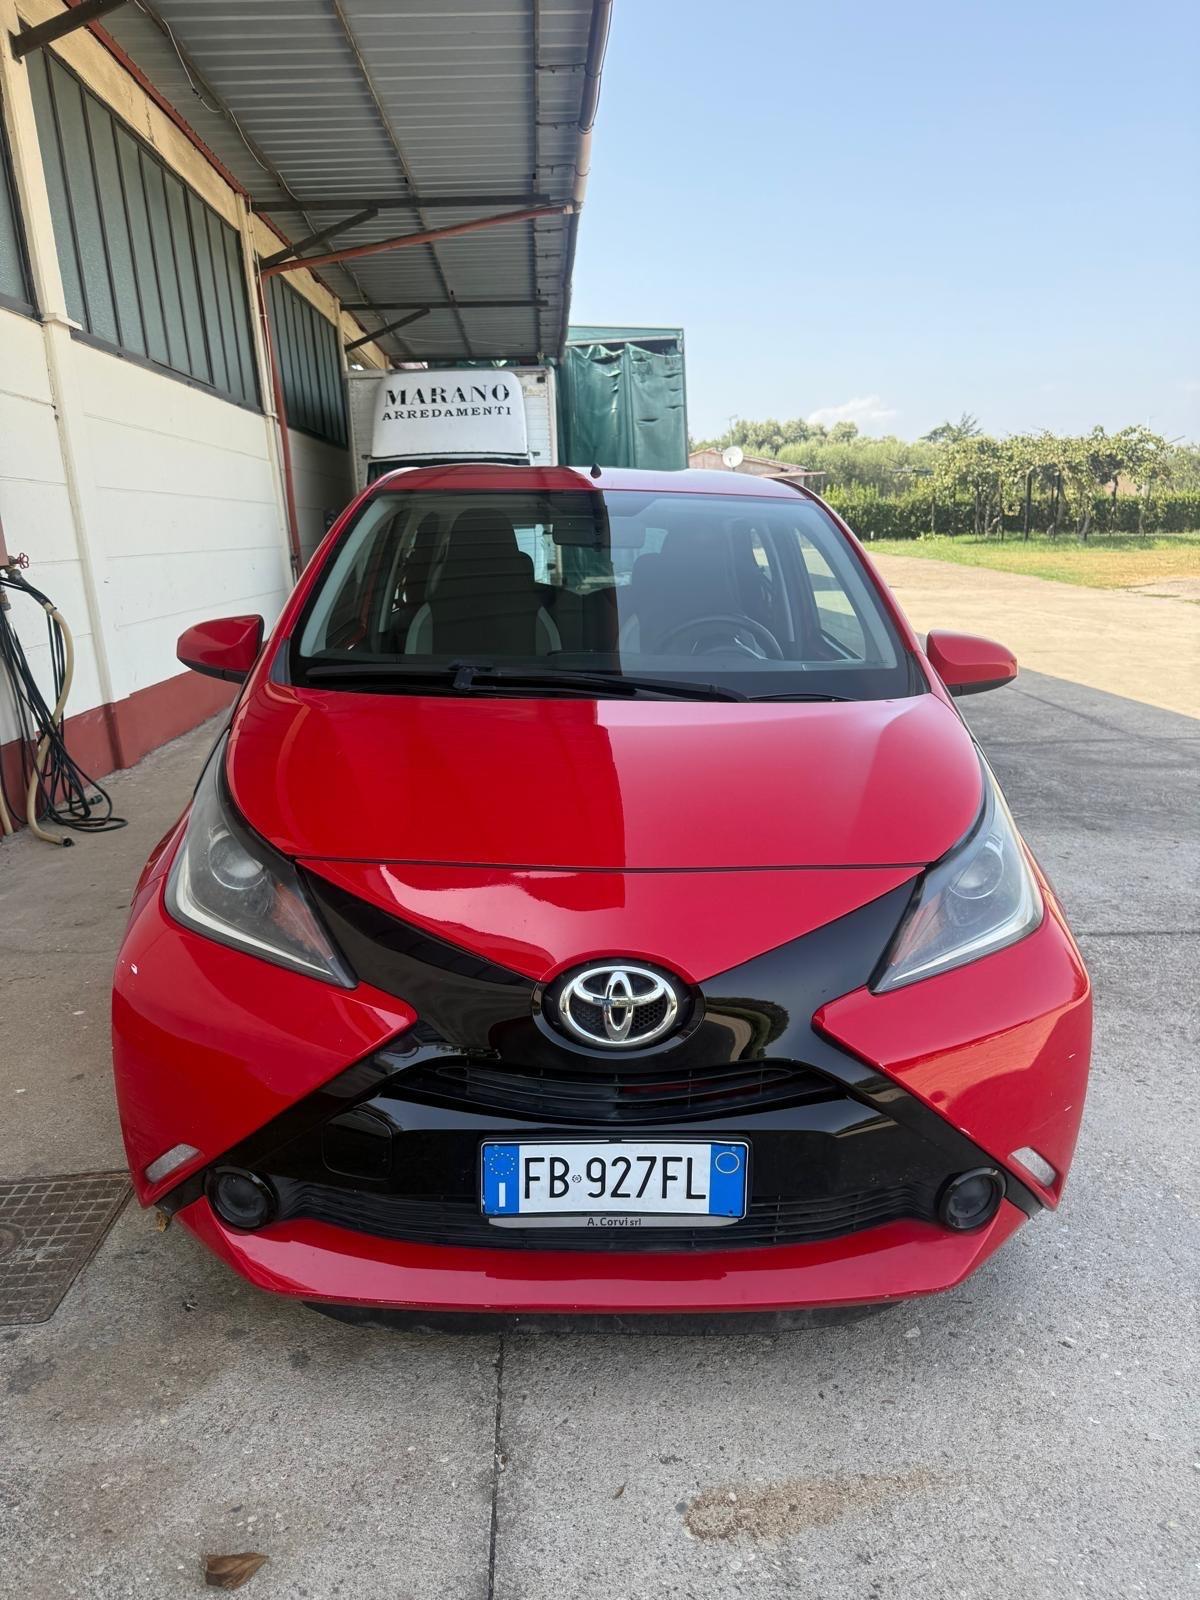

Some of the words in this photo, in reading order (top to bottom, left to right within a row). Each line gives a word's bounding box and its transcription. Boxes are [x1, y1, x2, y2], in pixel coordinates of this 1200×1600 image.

[385, 384, 510, 407] MARANO
[382, 406, 512, 421] ARREDAMENTI
[600, 1217, 628, 1226] Corvi
[629, 1218, 642, 1226] srl
